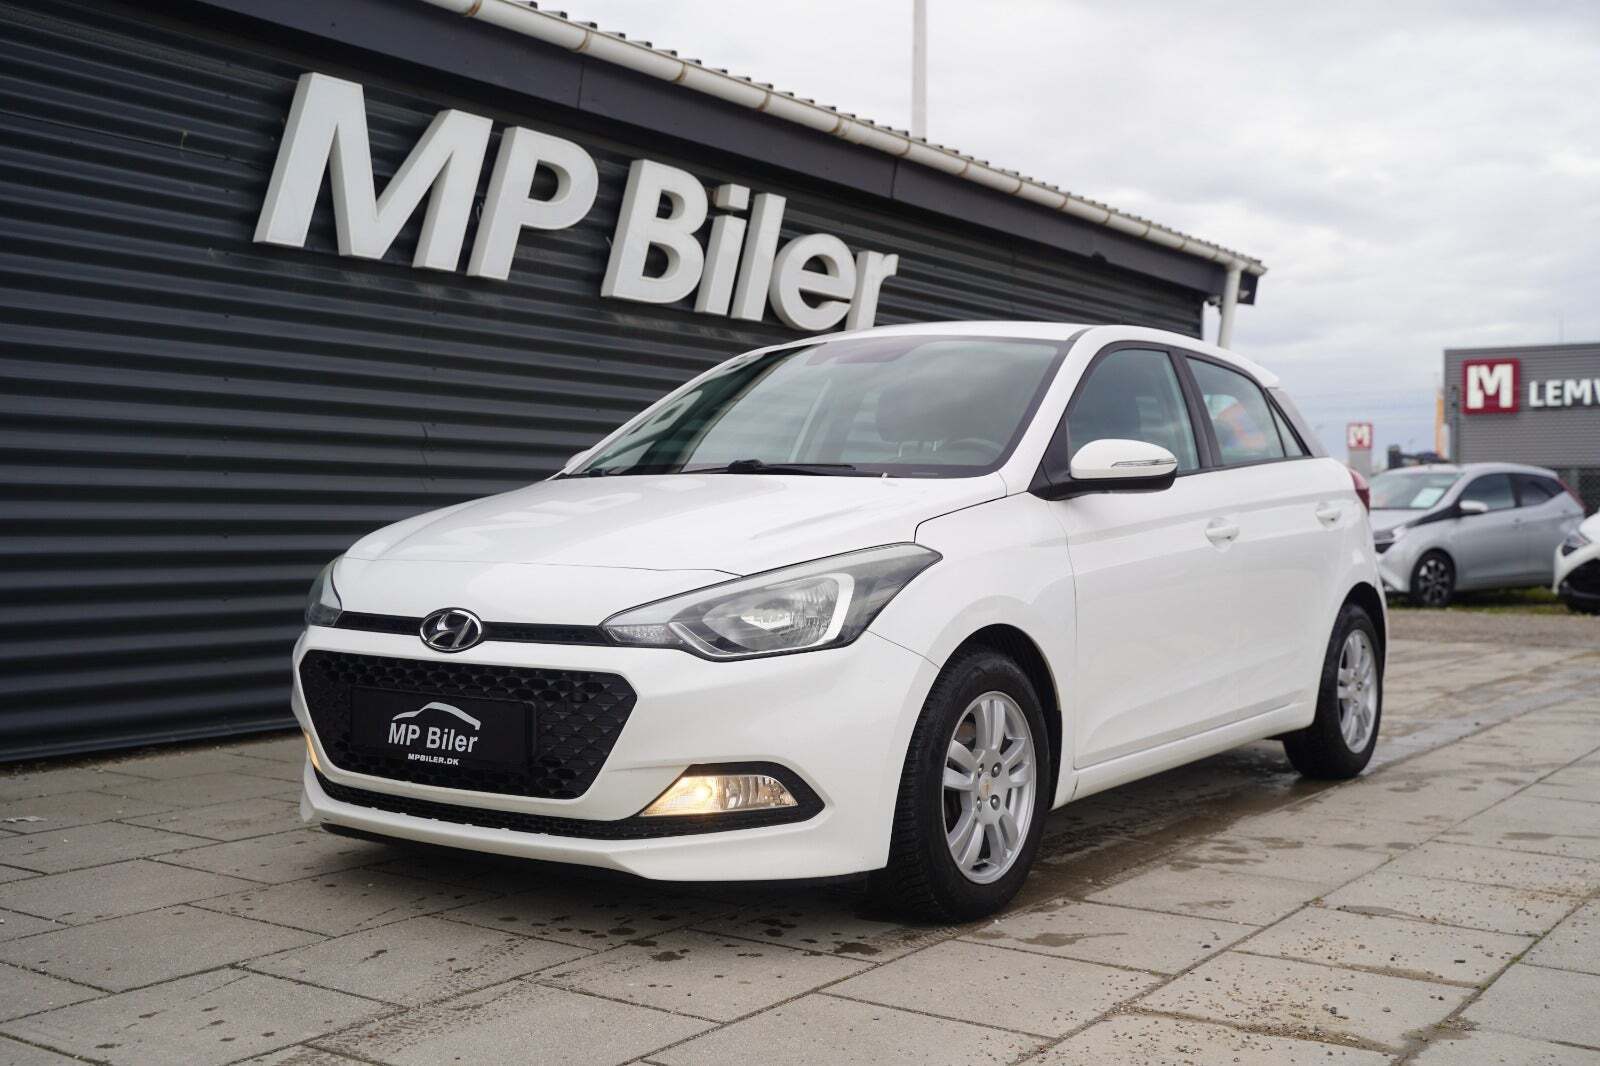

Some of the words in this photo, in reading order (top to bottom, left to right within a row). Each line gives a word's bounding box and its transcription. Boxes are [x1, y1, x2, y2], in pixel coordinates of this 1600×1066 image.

[253, 72, 599, 281] MP
[601, 159, 898, 332] Biler
[1529, 378, 1600, 407] LEM
[388, 722, 420, 745] MP
[426, 727, 478, 752] Biler
[407, 753, 459, 765] MPBILER.DK
